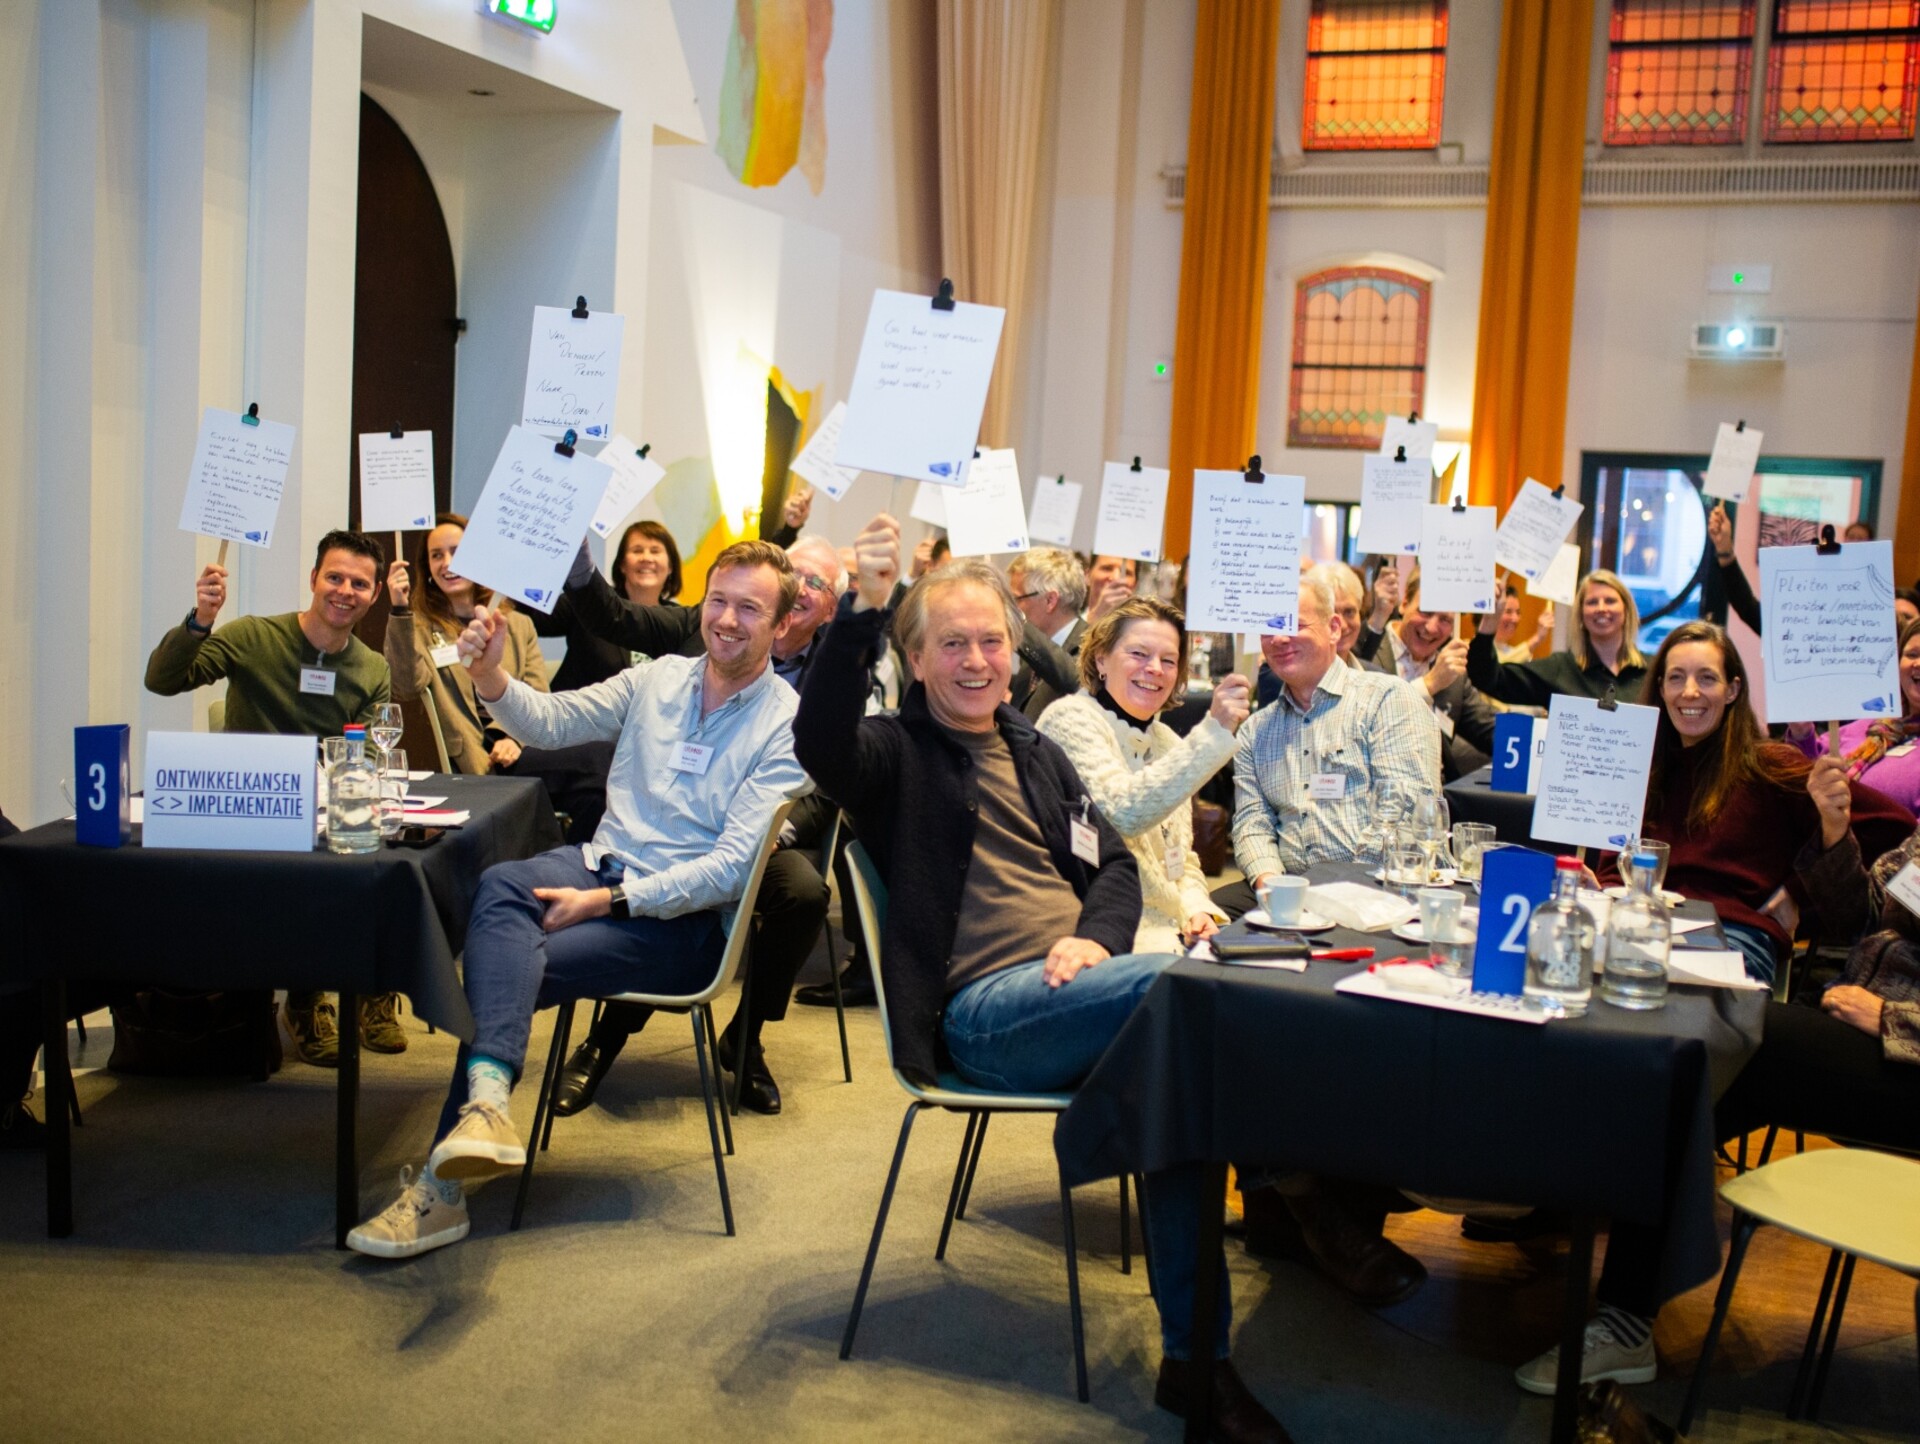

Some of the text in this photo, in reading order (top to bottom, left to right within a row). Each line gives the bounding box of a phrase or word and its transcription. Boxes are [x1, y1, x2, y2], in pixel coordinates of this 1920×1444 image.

[511, 460, 525, 475] Een
[1562, 732, 1585, 740] maar
[1504, 736, 1520, 769] 5
[88, 762, 106, 811] 3
[155, 769, 301, 791] ONTWIKKELKANSEN
[188, 795, 303, 816] IMPLEMENTATIE
[1499, 894, 1531, 953] 2
